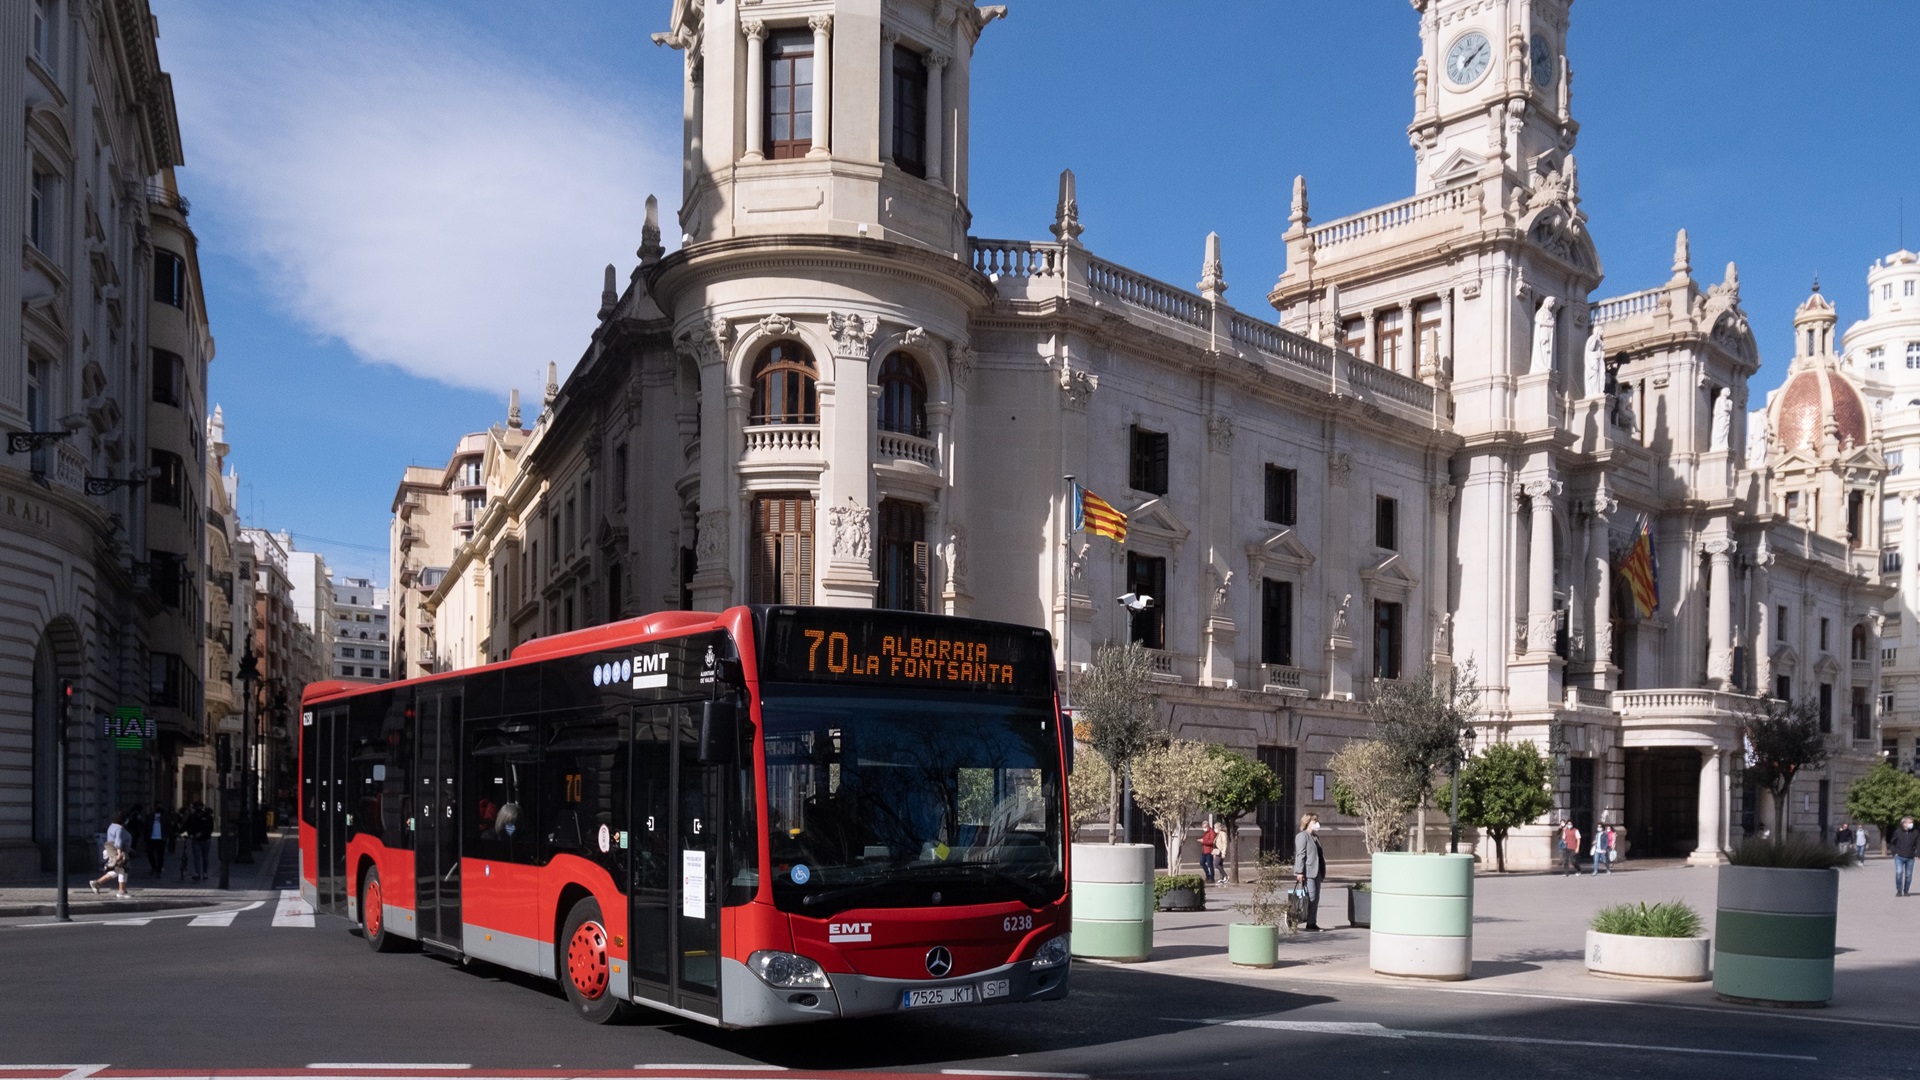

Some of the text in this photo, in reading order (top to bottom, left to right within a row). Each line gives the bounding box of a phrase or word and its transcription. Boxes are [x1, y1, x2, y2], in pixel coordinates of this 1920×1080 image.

[804, 629, 849, 674] 70
[882, 635, 988, 663] ALBORAIA
[633, 652, 670, 674] EMT
[852, 654, 1013, 684] LA FONTSANTA
[565, 774, 582, 802] 70
[829, 922, 872, 935] EMT
[1003, 915, 1033, 932] 6238
[912, 990, 943, 1005] 7525
[949, 987, 971, 1002] JKT
[986, 981, 1007, 997] SP
